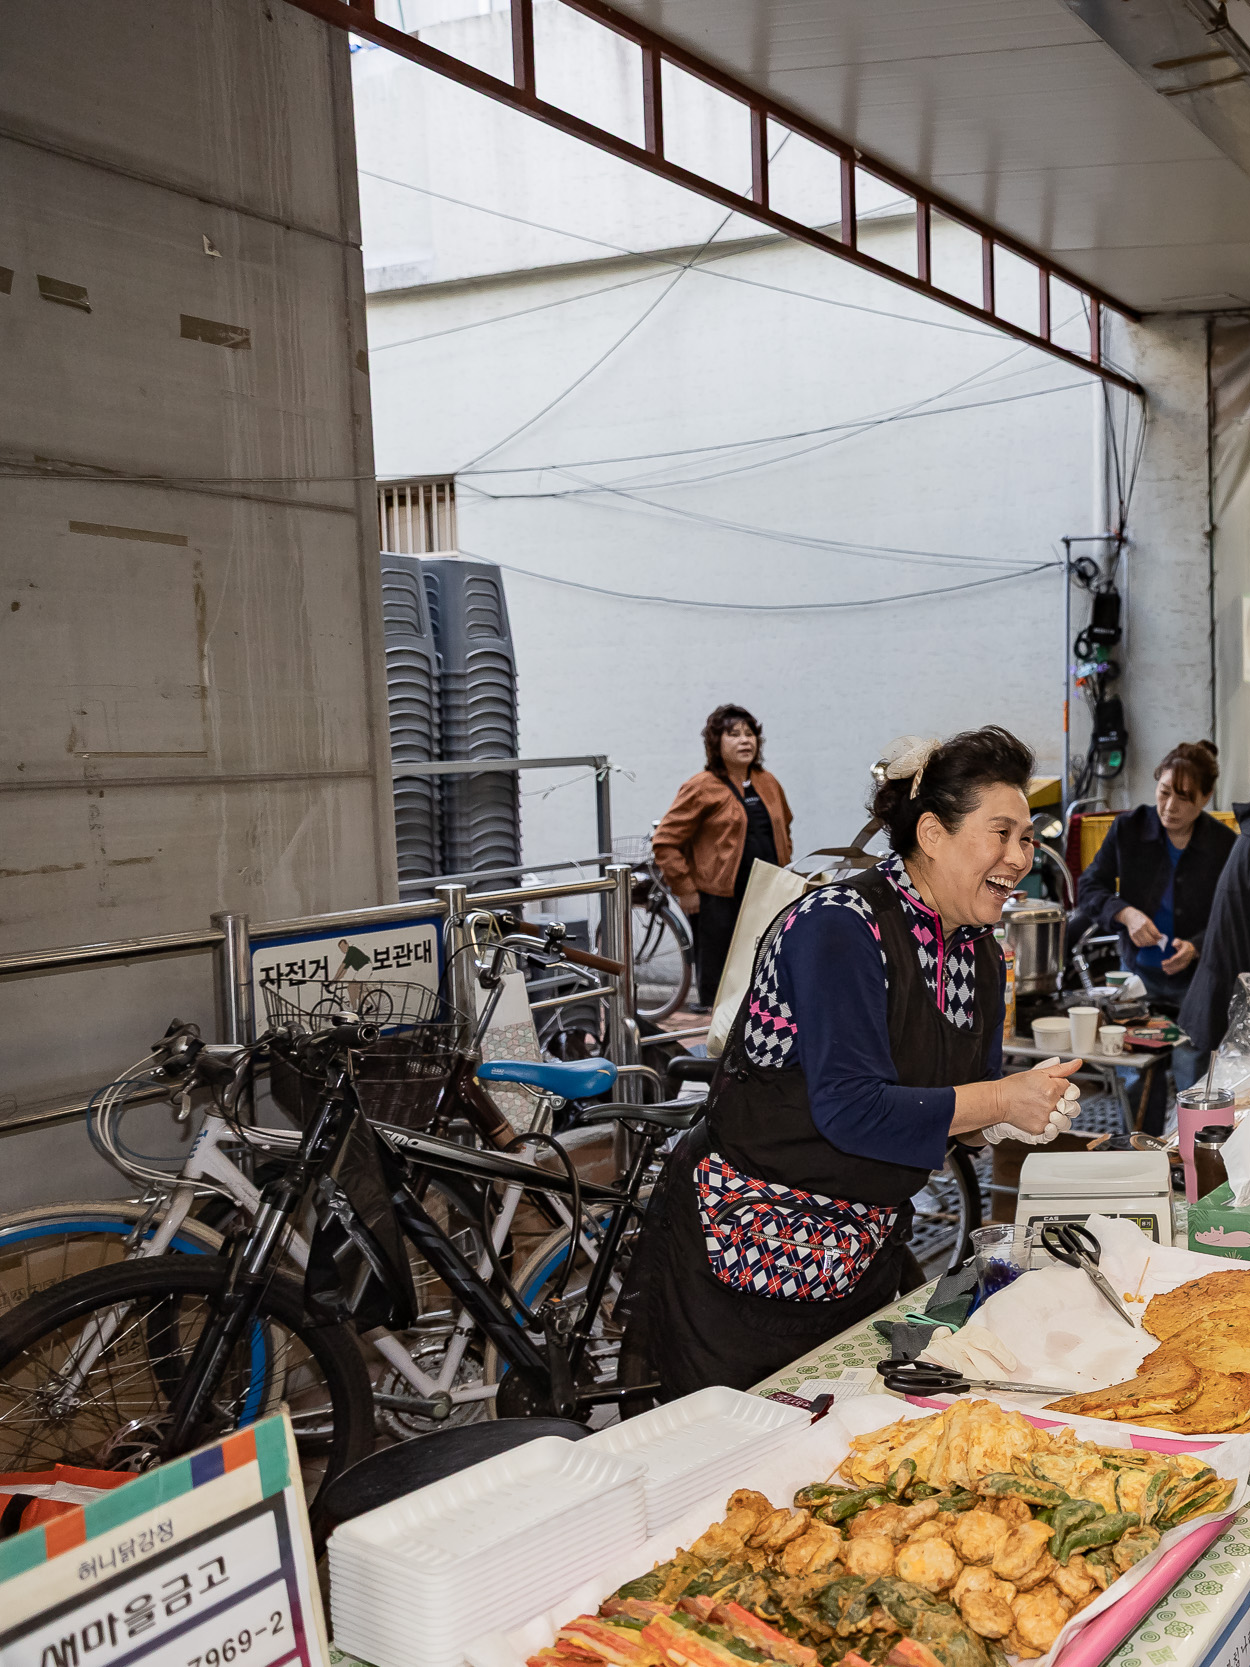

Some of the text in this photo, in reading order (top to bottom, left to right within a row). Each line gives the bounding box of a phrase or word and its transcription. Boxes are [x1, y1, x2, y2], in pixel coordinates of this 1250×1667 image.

[260, 939, 432, 990] 자전거 보관대
[40, 1555, 231, 1667] 새마을금고
